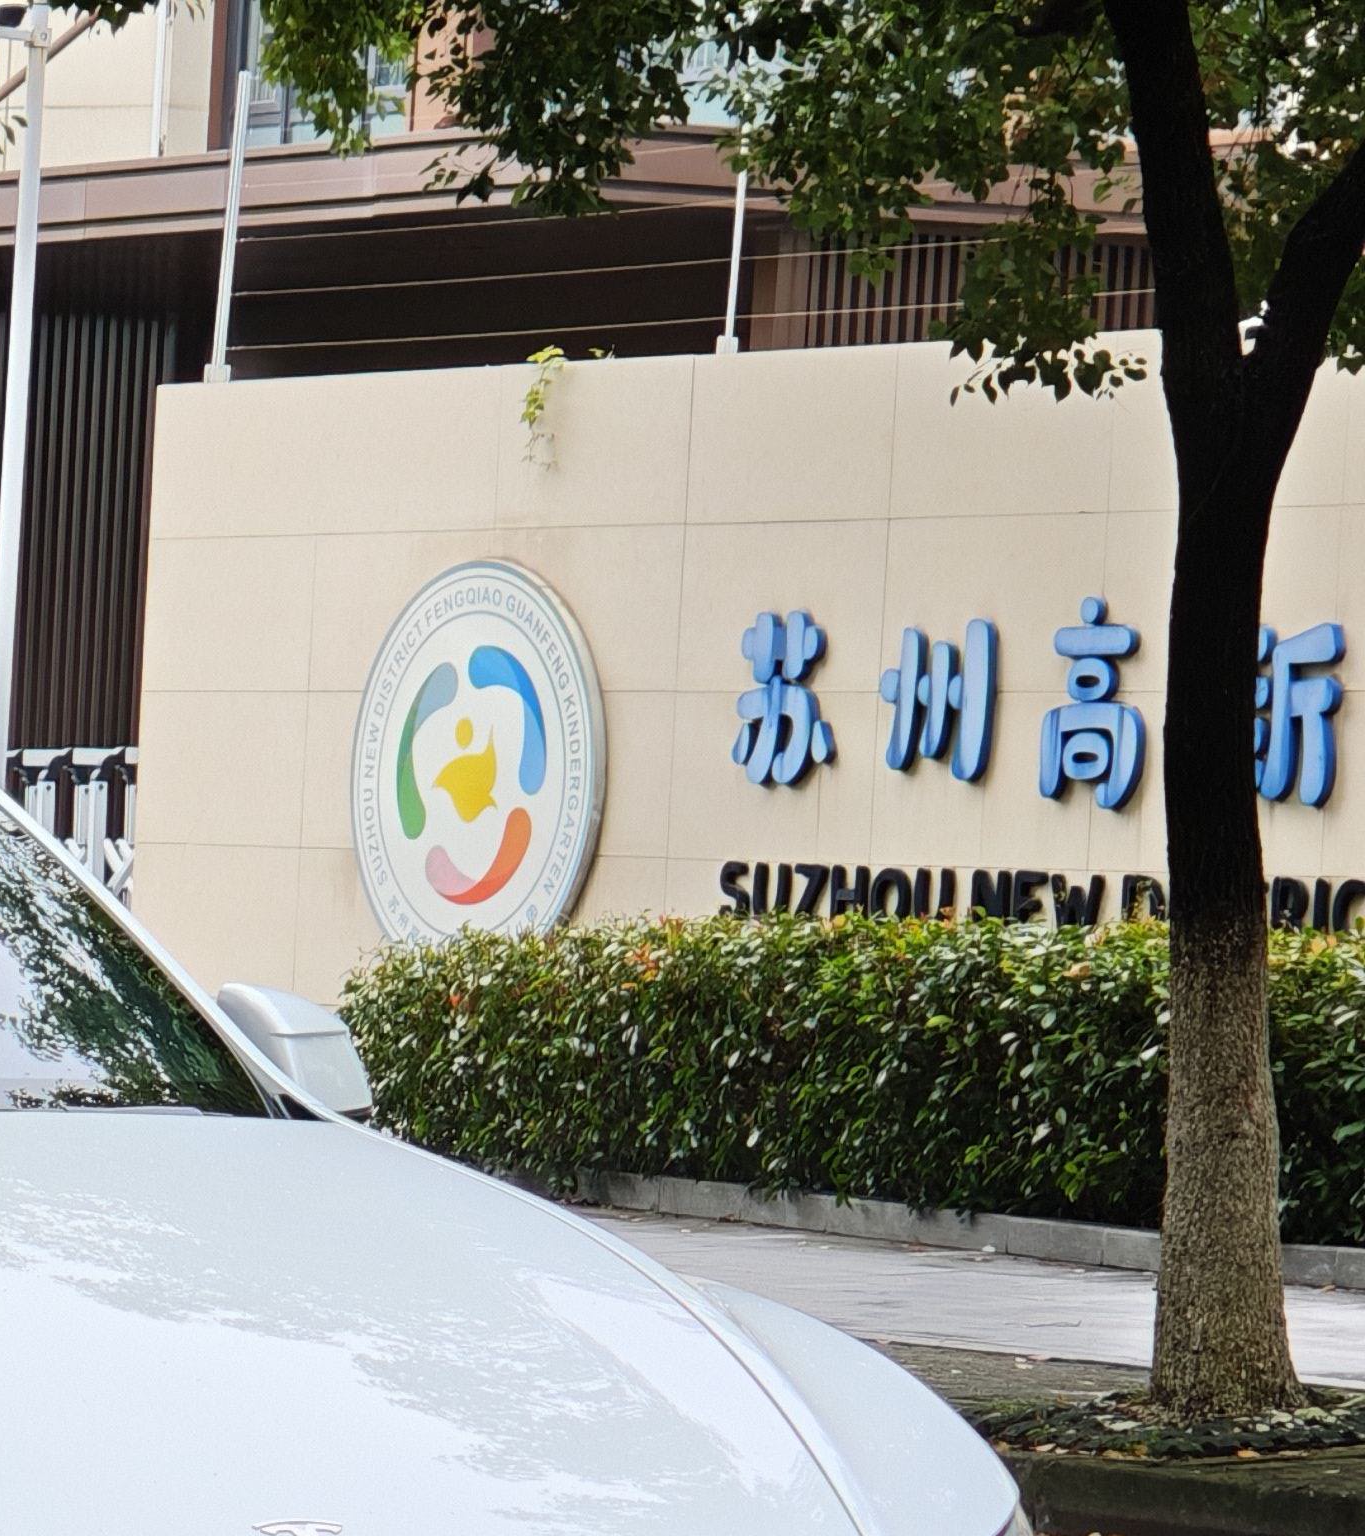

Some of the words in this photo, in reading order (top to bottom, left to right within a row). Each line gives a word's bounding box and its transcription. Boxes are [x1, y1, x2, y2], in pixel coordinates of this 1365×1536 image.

[425, 586, 503, 628] FENGQIAO
[505, 593, 570, 691] GUANFENG
[376, 619, 427, 718] DISTRICT
[362, 726, 381, 778] NEW
[543, 693, 582, 896] KINDERGARTEN
[363, 787, 389, 887] SUZHOU
[720, 861, 958, 920] SUZHOU
[972, 869, 1106, 929] NEW
